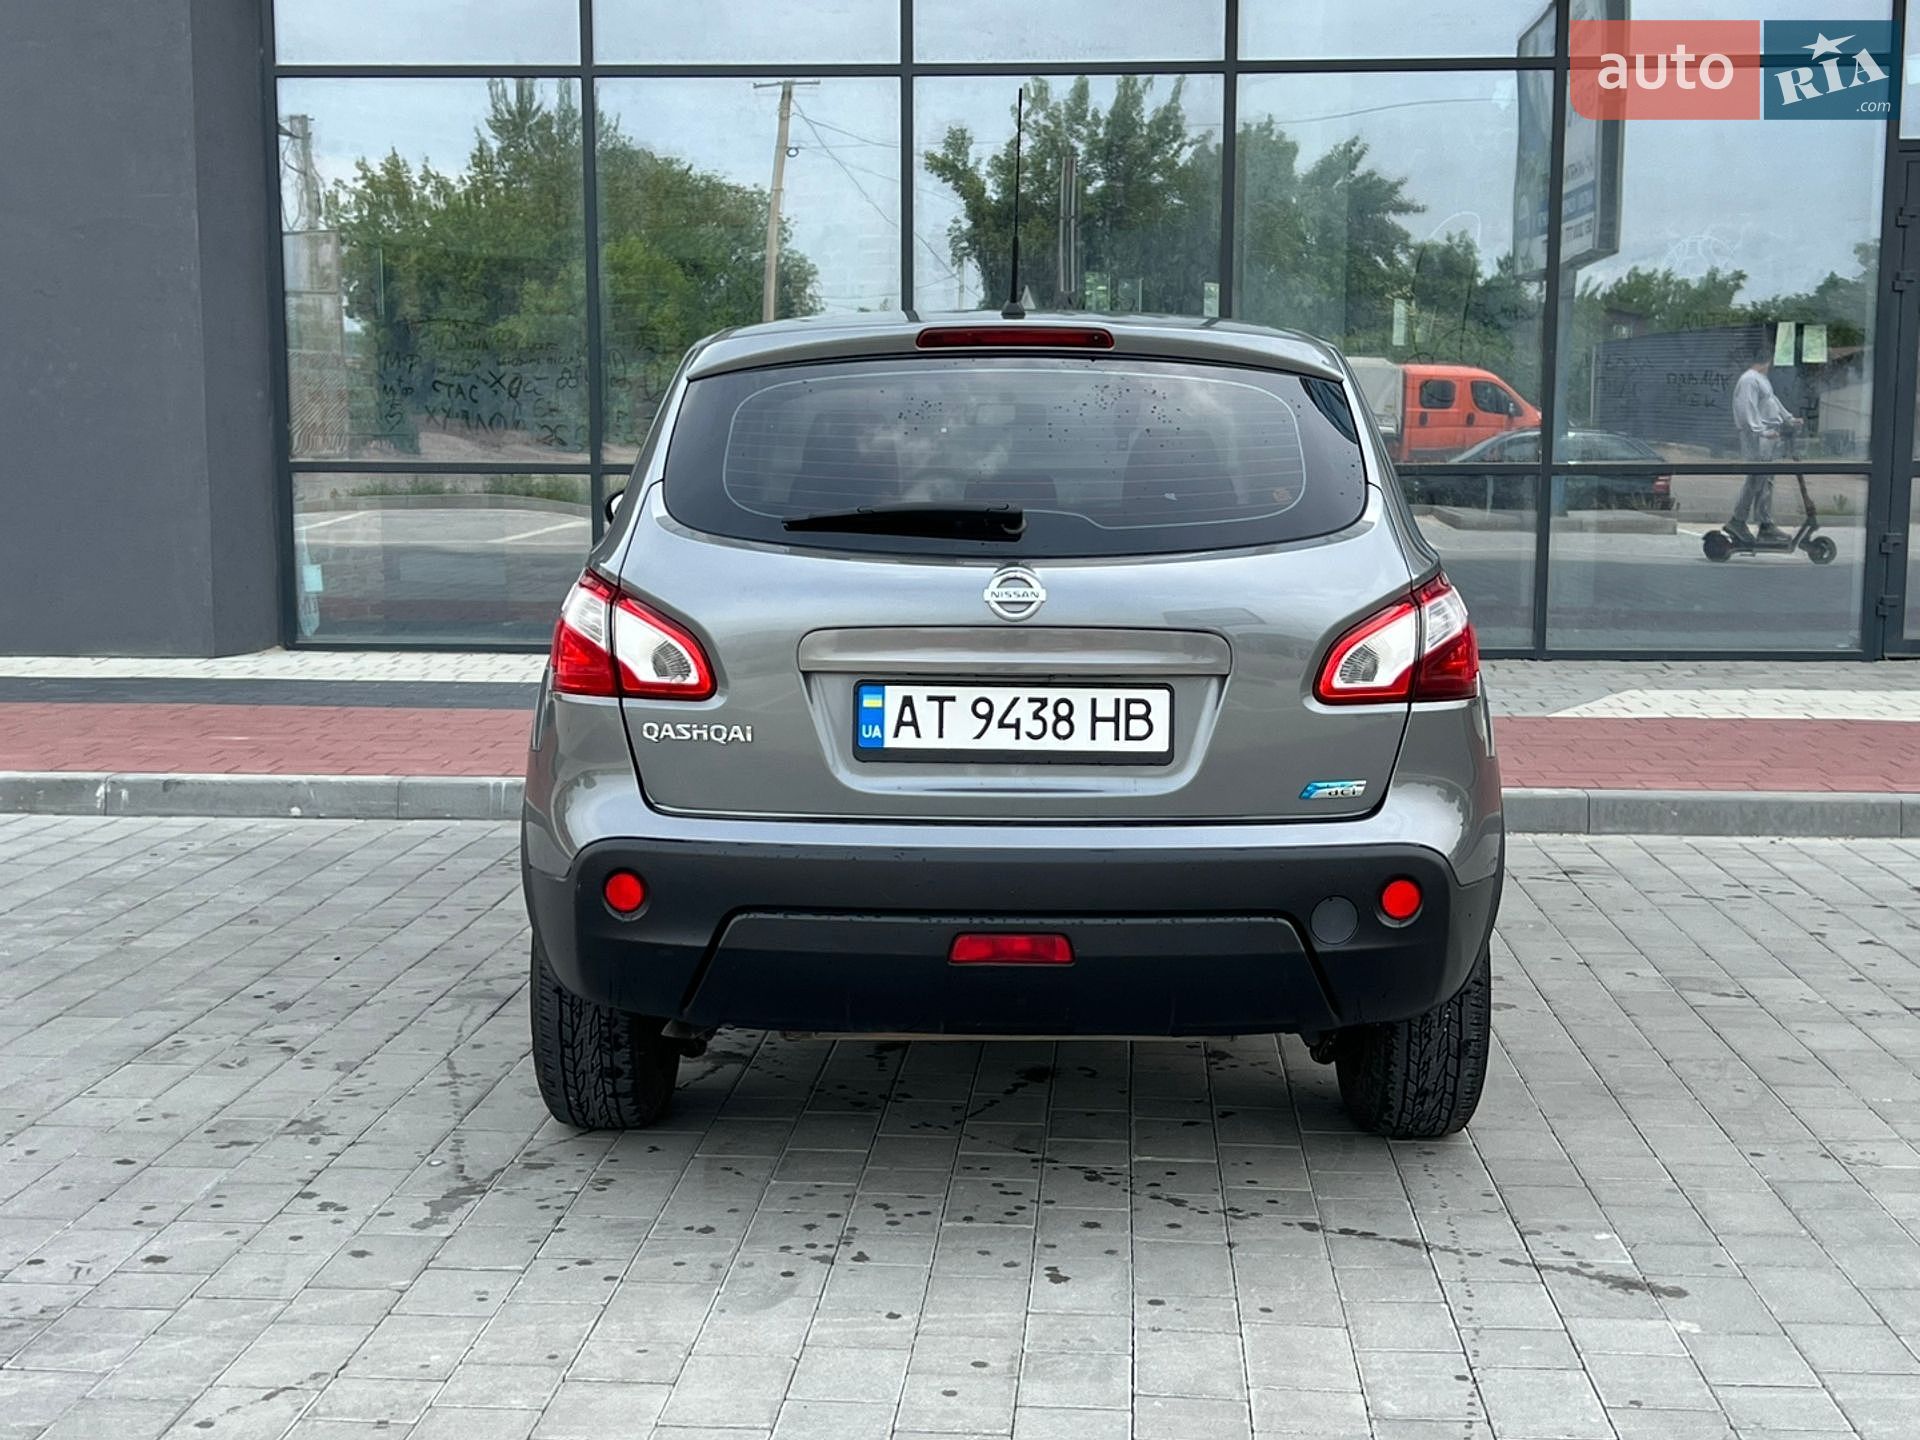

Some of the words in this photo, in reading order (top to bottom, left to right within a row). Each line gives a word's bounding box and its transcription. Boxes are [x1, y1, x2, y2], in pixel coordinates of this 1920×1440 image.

[990, 590, 1040, 599] NISSAN
[892, 695, 957, 739] AT
[970, 696, 1075, 741] 9438
[1090, 697, 1154, 742] HB
[642, 722, 752, 744] QASHQAI
[861, 725, 882, 739] UA
